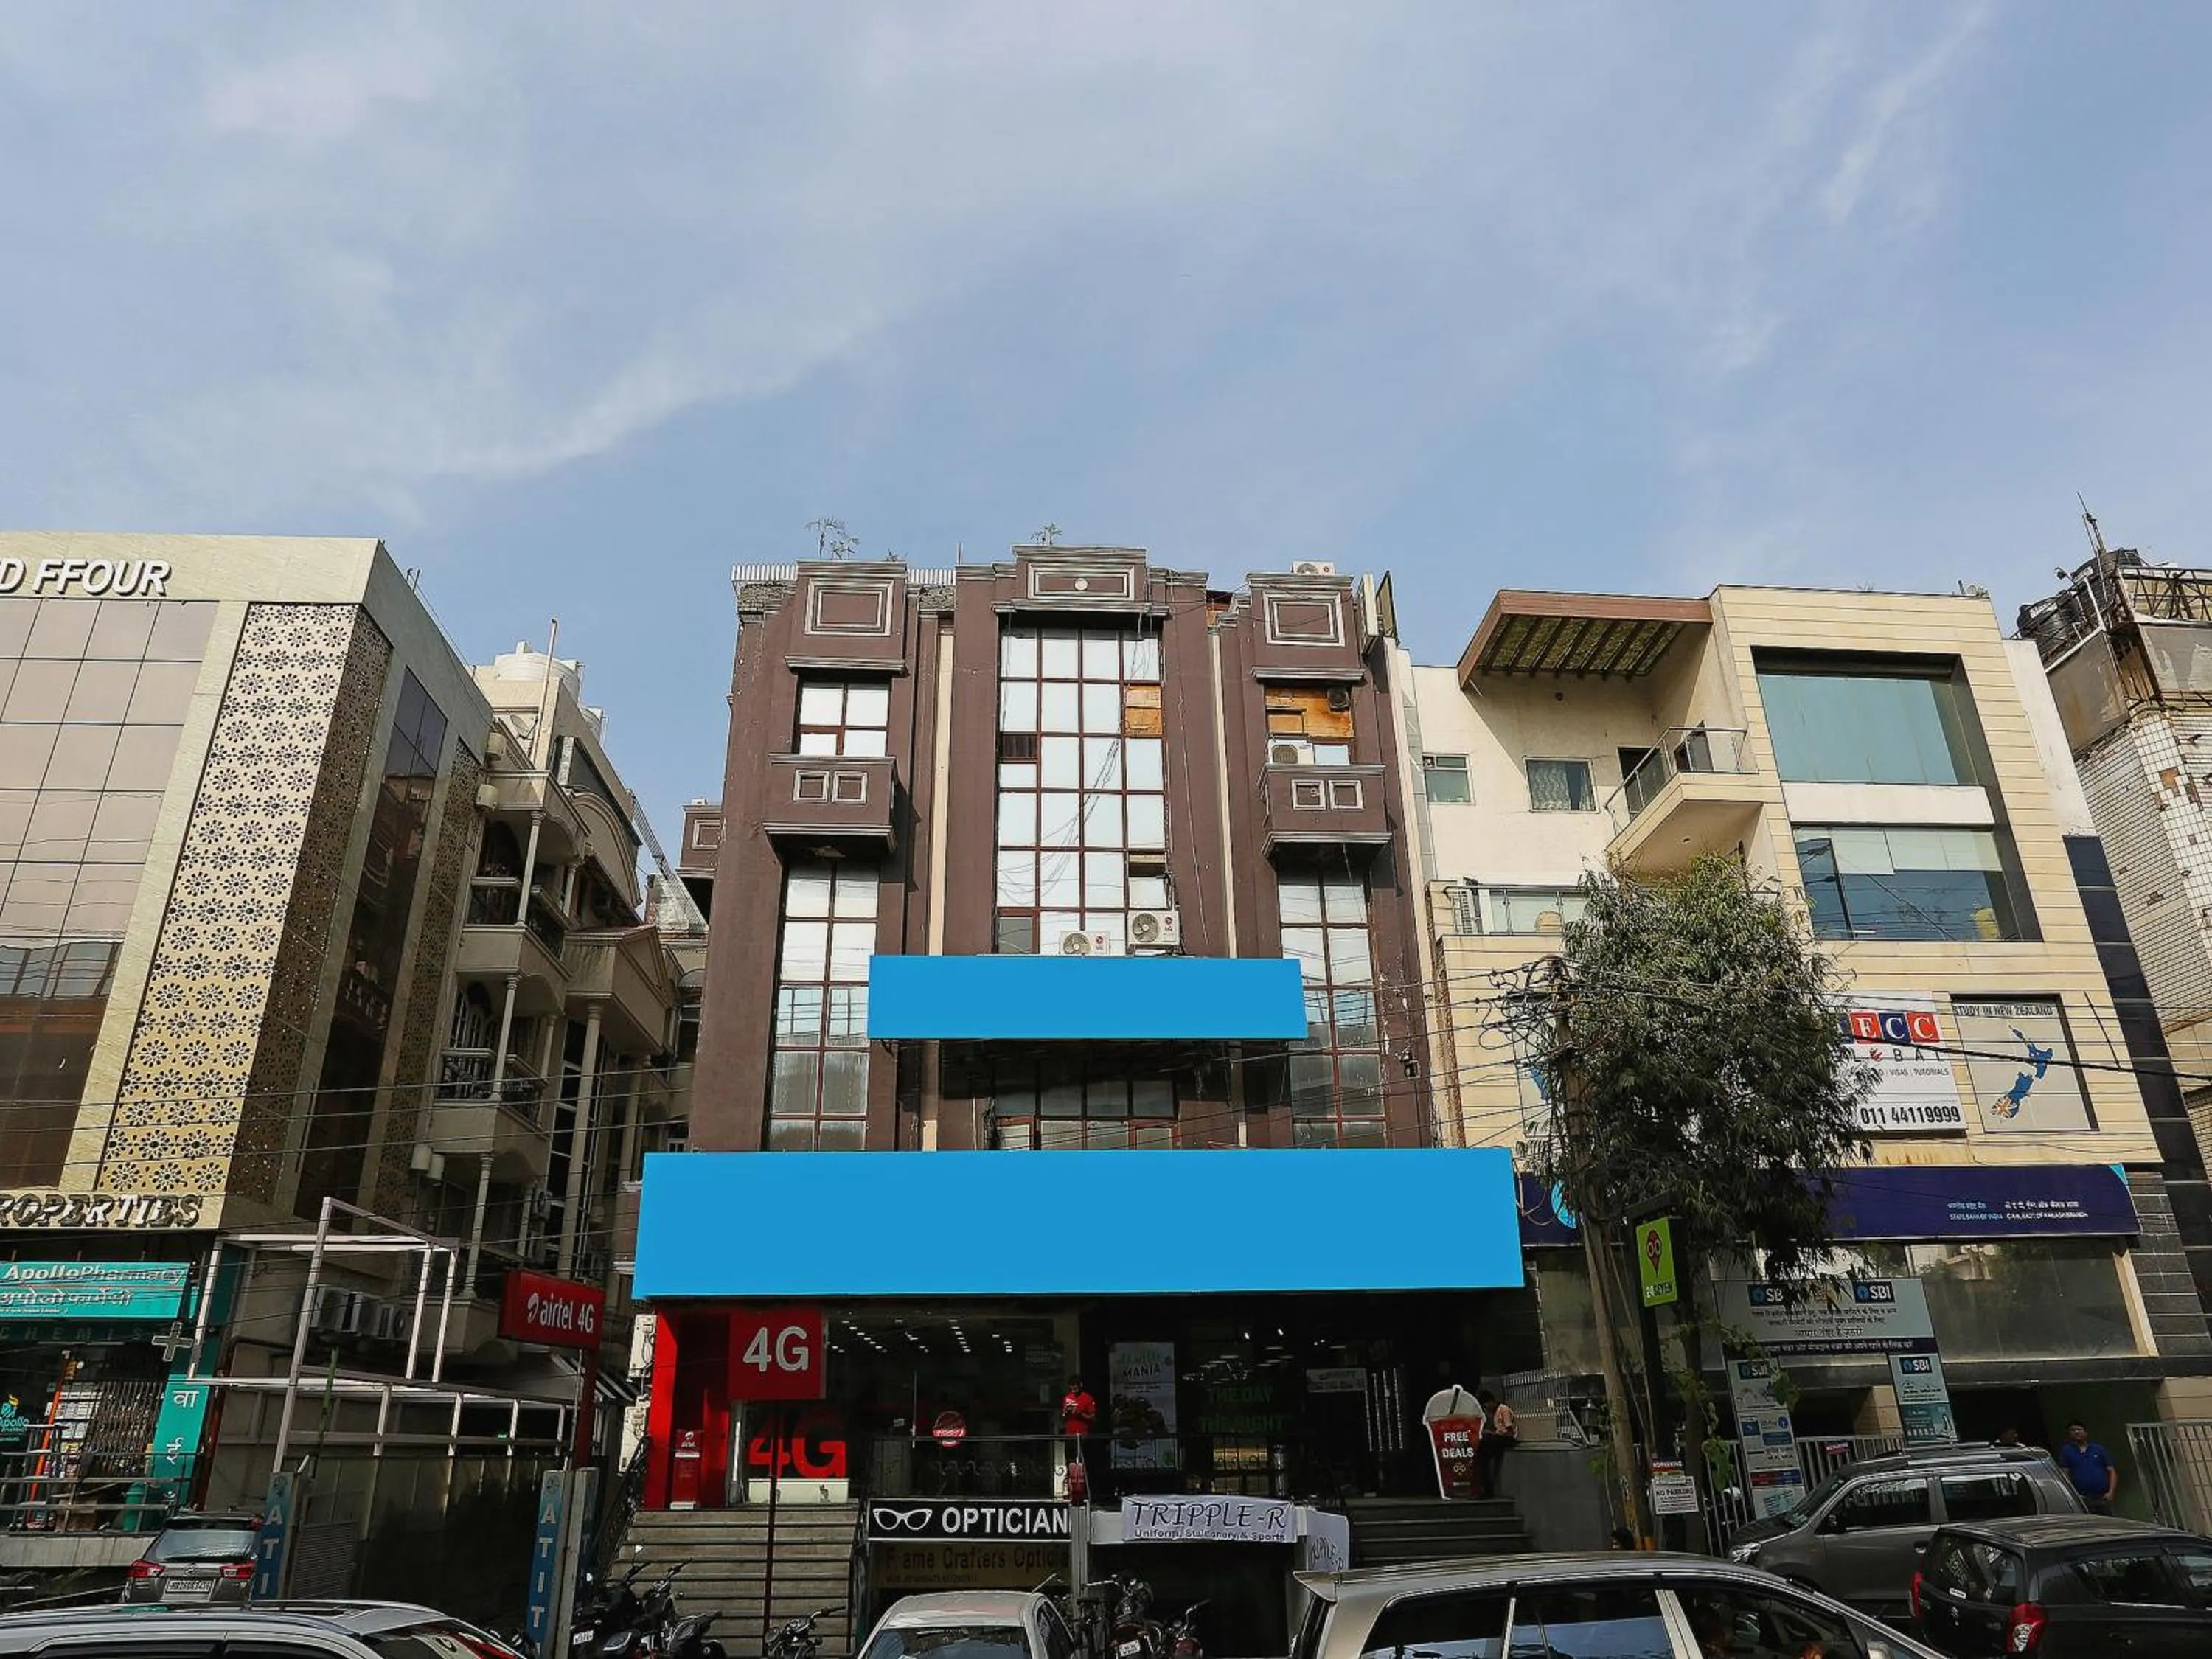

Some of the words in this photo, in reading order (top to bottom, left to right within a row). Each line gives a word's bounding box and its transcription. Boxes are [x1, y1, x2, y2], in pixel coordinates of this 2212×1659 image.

[0, 558, 26, 593] D
[33, 558, 171, 596] FFOUR
[1993, 1006, 2011, 1015] NEW
[2014, 1005, 2053, 1015] ZEALAND
[1860, 1107, 1885, 1124] 011
[1891, 1105, 1961, 1124] 44119999
[1766, 1285, 1784, 1302] SB
[1871, 1285, 1892, 1299] SBI
[540, 1291, 574, 1329] airtel
[577, 1303, 594, 1334] 4G
[743, 1326, 809, 1372] 4G
[1443, 1431, 1470, 1442] FREE
[1441, 1447, 1475, 1458] DEALS
[941, 1506, 1071, 1534] OPTICIAN
[1132, 1501, 1253, 1528] TRIPPLE
[1251, 1531, 1287, 1541] Sports
[886, 1547, 935, 1570] Fame
[1014, 1545, 1071, 1576] Opticia
